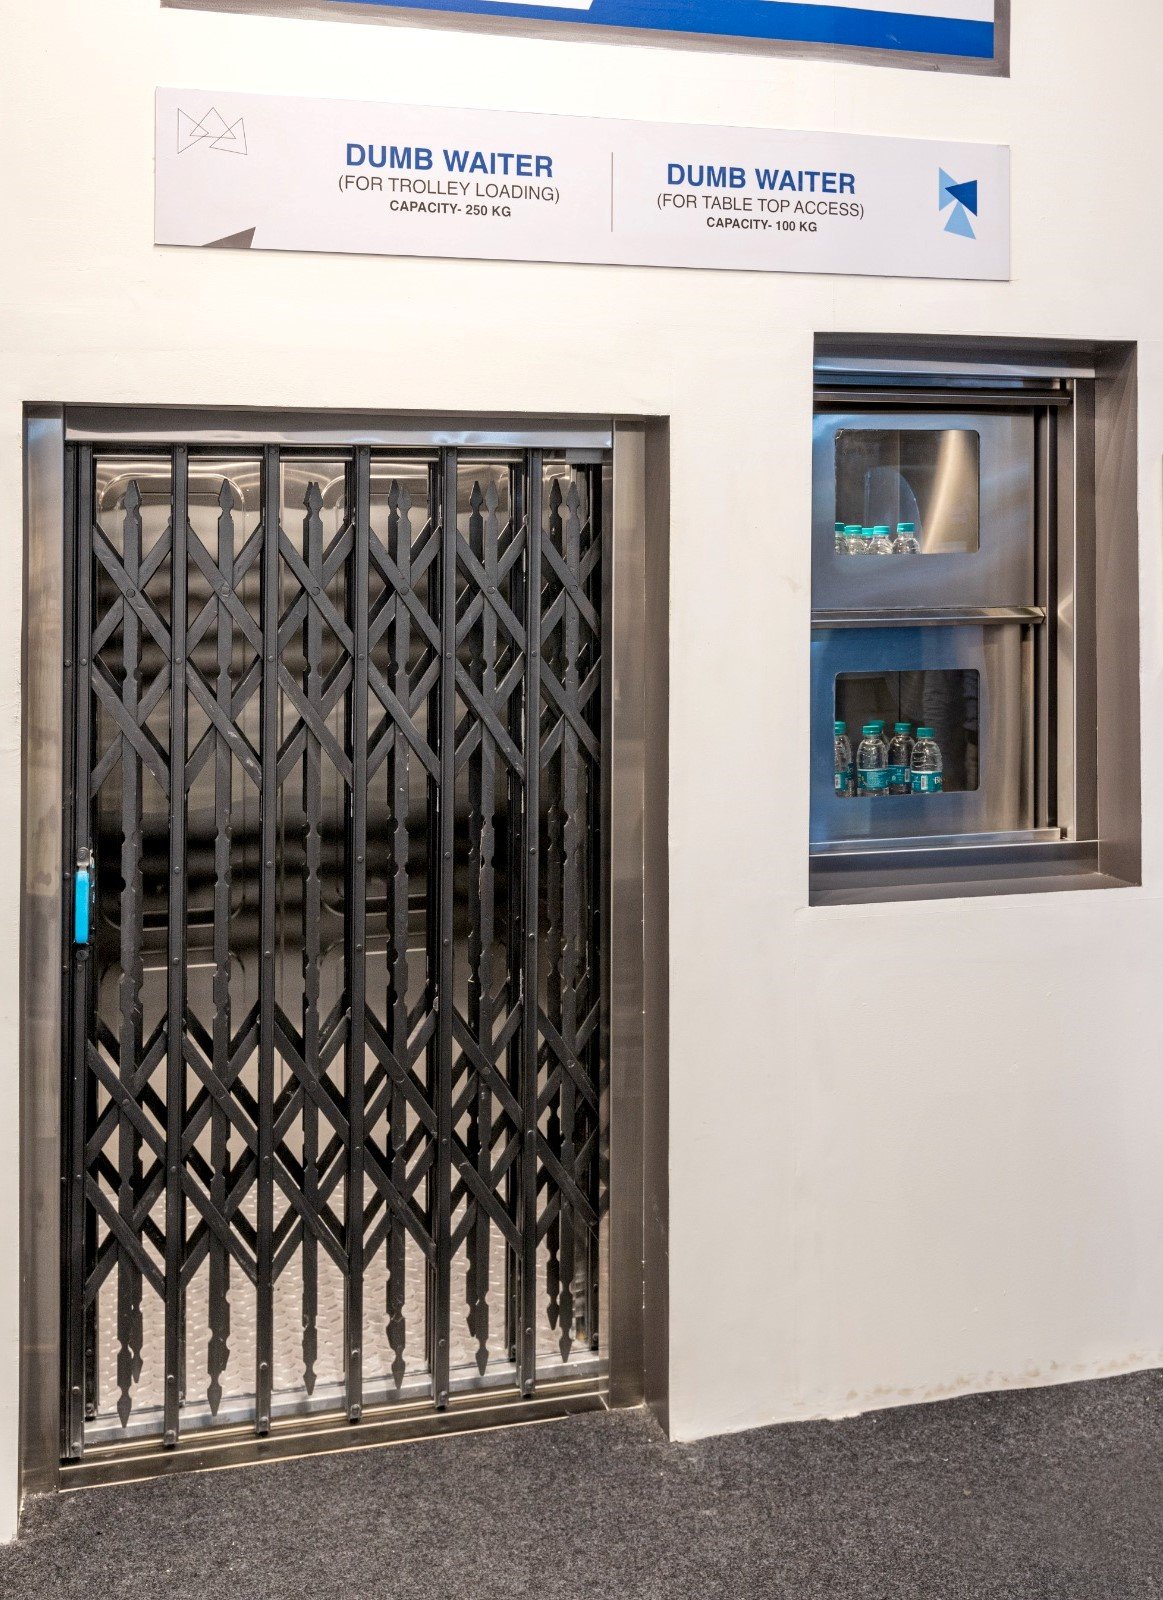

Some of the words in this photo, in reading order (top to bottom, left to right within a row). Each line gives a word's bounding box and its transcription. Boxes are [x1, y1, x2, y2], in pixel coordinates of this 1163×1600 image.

[347, 144, 433, 170] DUMB
[443, 150, 552, 177] WAITER
[339, 175, 382, 192] (FOR
[388, 178, 470, 195] TROLLEY
[476, 183, 559, 204] LOADING)
[668, 164, 746, 188] DUMB
[755, 169, 855, 194] WAITER
[390, 200, 462, 214] CAPACITY-
[466, 205, 487, 215] 250
[492, 206, 511, 217] KG
[658, 194, 697, 210] (FOR
[702, 196, 752, 211] TABLE
[757, 199, 790, 213] TOP
[794, 201, 864, 220] ACCESS)
[707, 217, 772, 229] CAPACITY-
[776, 221, 795, 231] 100
[800, 222, 817, 232] KG
